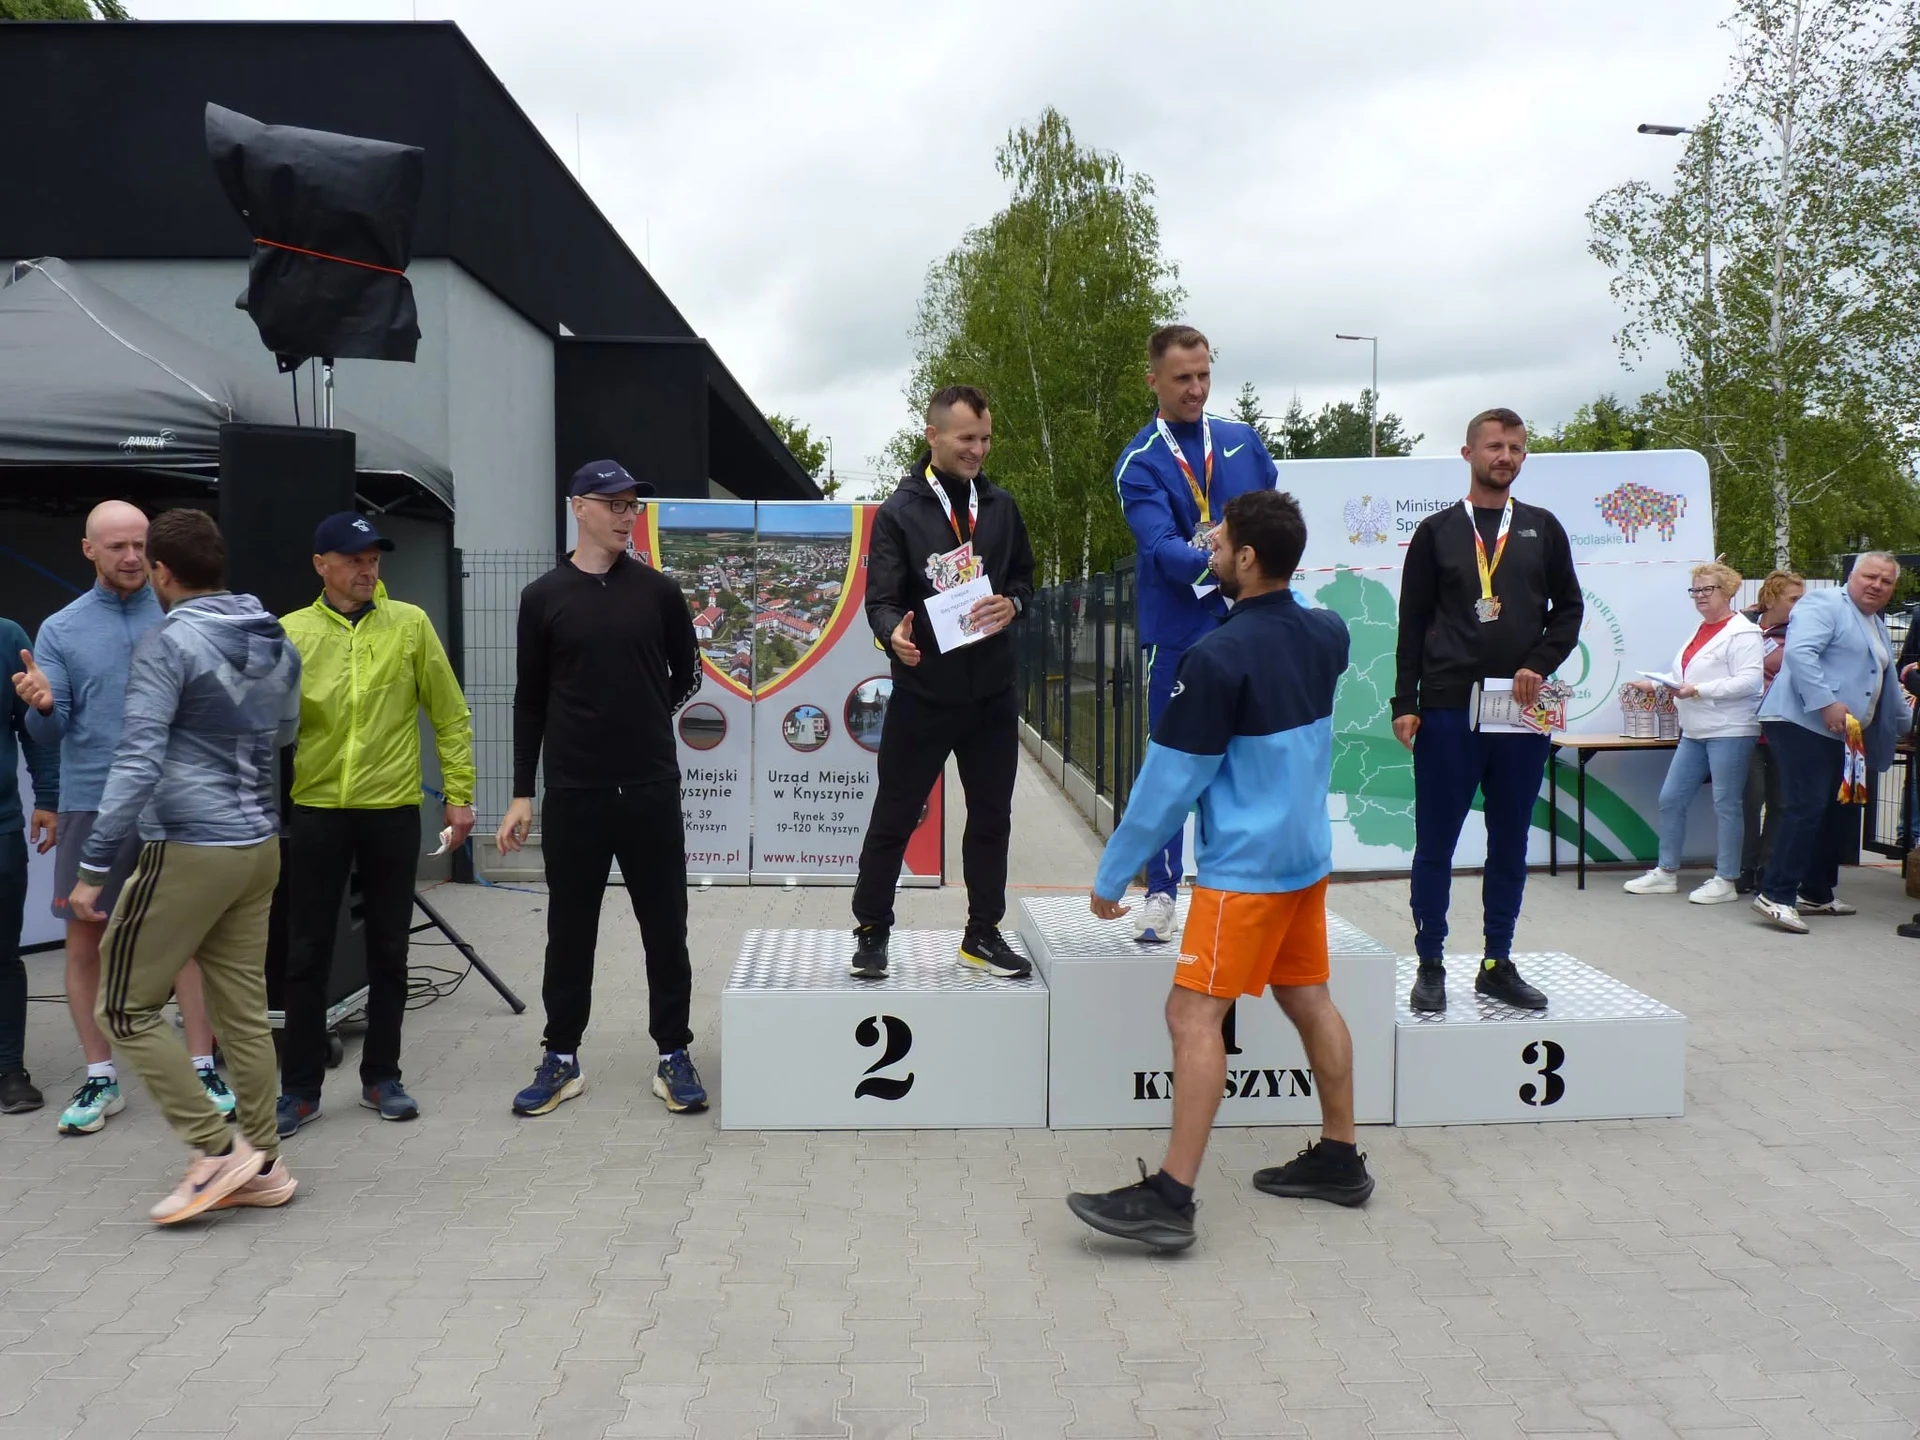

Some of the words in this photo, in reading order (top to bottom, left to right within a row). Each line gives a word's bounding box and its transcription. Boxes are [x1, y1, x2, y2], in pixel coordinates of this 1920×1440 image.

[1396, 499, 1455, 512] Minister
[1570, 532, 1623, 546] Podlaskie
[1291, 573, 1306, 581] ZS
[686, 768, 738, 784] Miejski
[768, 770, 809, 786] Urząd
[819, 771, 870, 786] Miejski
[680, 785, 732, 800] yszynie
[773, 789, 785, 799] w
[793, 786, 864, 803] Knyszynie
[698, 809, 712, 819] 39
[793, 811, 825, 823] Rynek
[831, 812, 845, 821] 39
[685, 821, 727, 833] Knyszyn
[777, 823, 811, 833] 19-120
[818, 823, 860, 836] Knyszyn
[684, 849, 740, 865] yszyn.pl
[763, 850, 859, 867] www.knyszyn.
[855, 1015, 915, 1101] 2
[1519, 1040, 1566, 1106] 3
